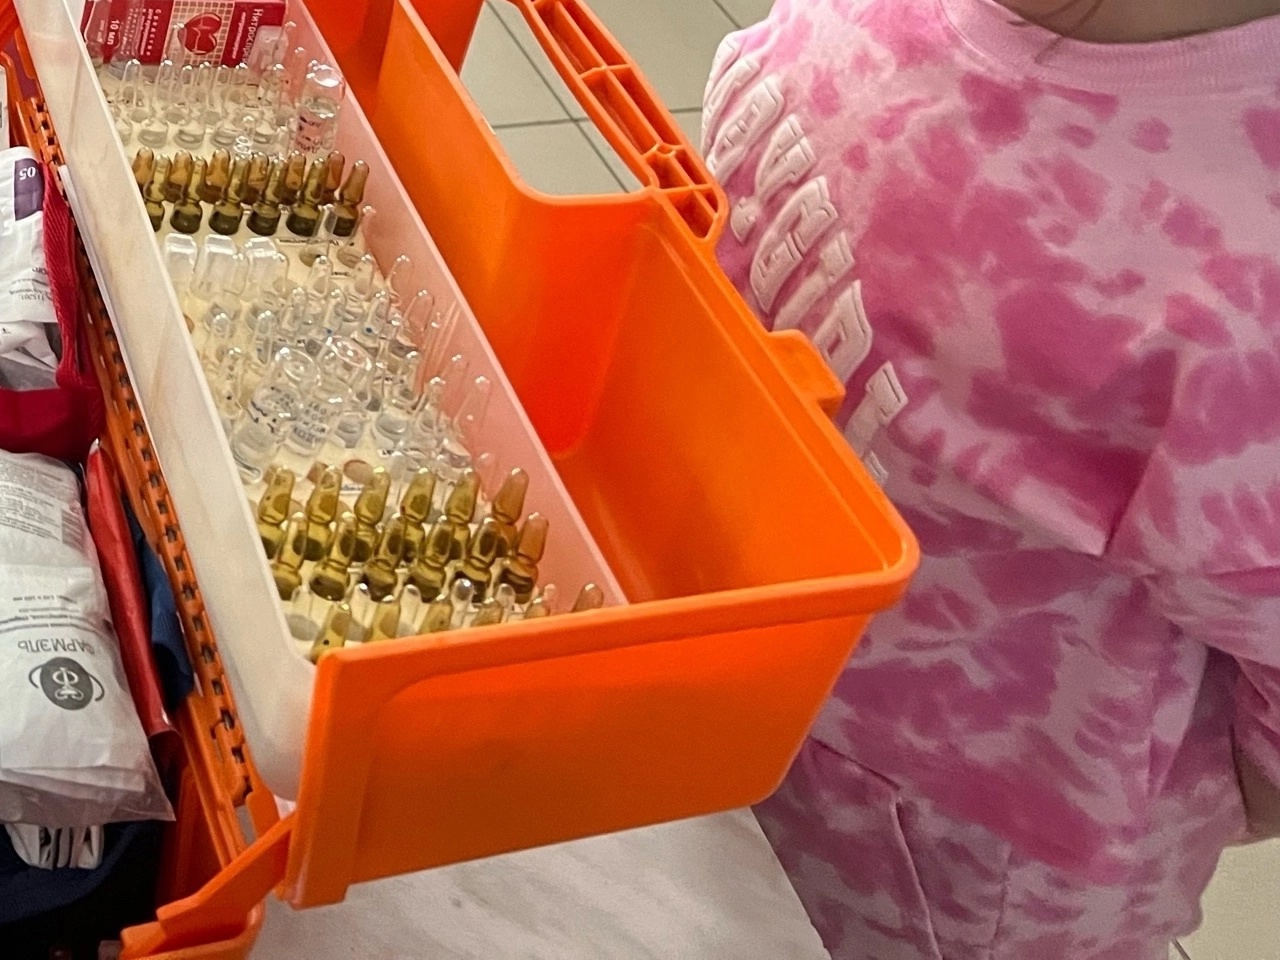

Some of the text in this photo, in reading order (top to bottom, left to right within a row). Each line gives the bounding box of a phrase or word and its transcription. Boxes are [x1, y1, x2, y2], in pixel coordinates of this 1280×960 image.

[107, 20, 120, 45] 10 мл
[19, 166, 36, 180] 05
